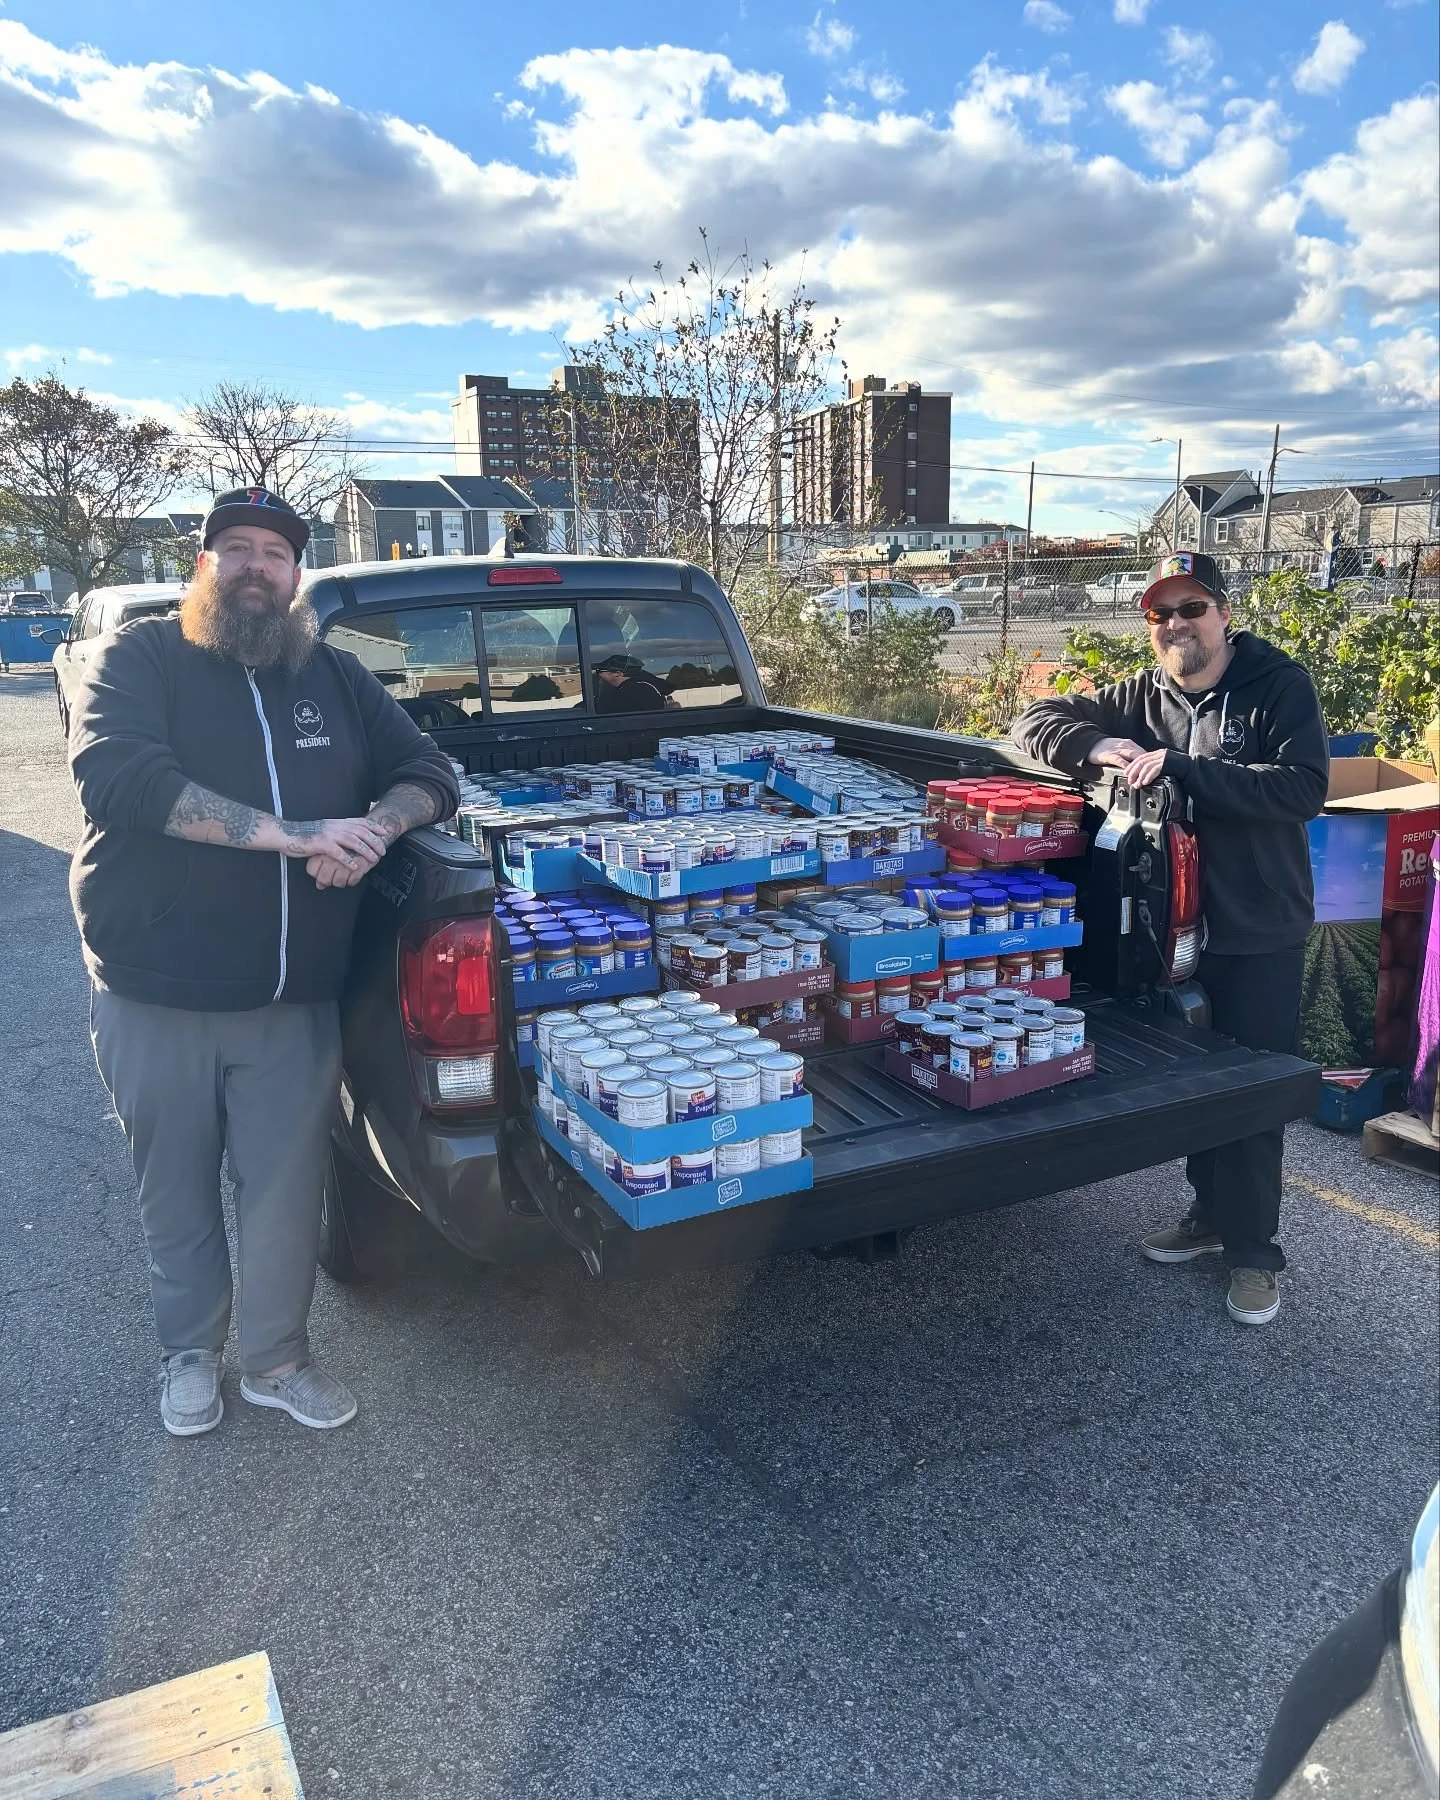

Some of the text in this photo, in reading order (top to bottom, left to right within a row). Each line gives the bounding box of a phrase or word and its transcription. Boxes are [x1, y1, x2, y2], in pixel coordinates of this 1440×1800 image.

[295, 736, 331, 749] PRESIDENT
[1402, 829, 1434, 844] PREMIU
[1399, 847, 1430, 876] Re
[1399, 875, 1428, 889] POTAT
[673, 1169, 707, 1180] Evaporated
[625, 1180, 659, 1190] Evaporated
